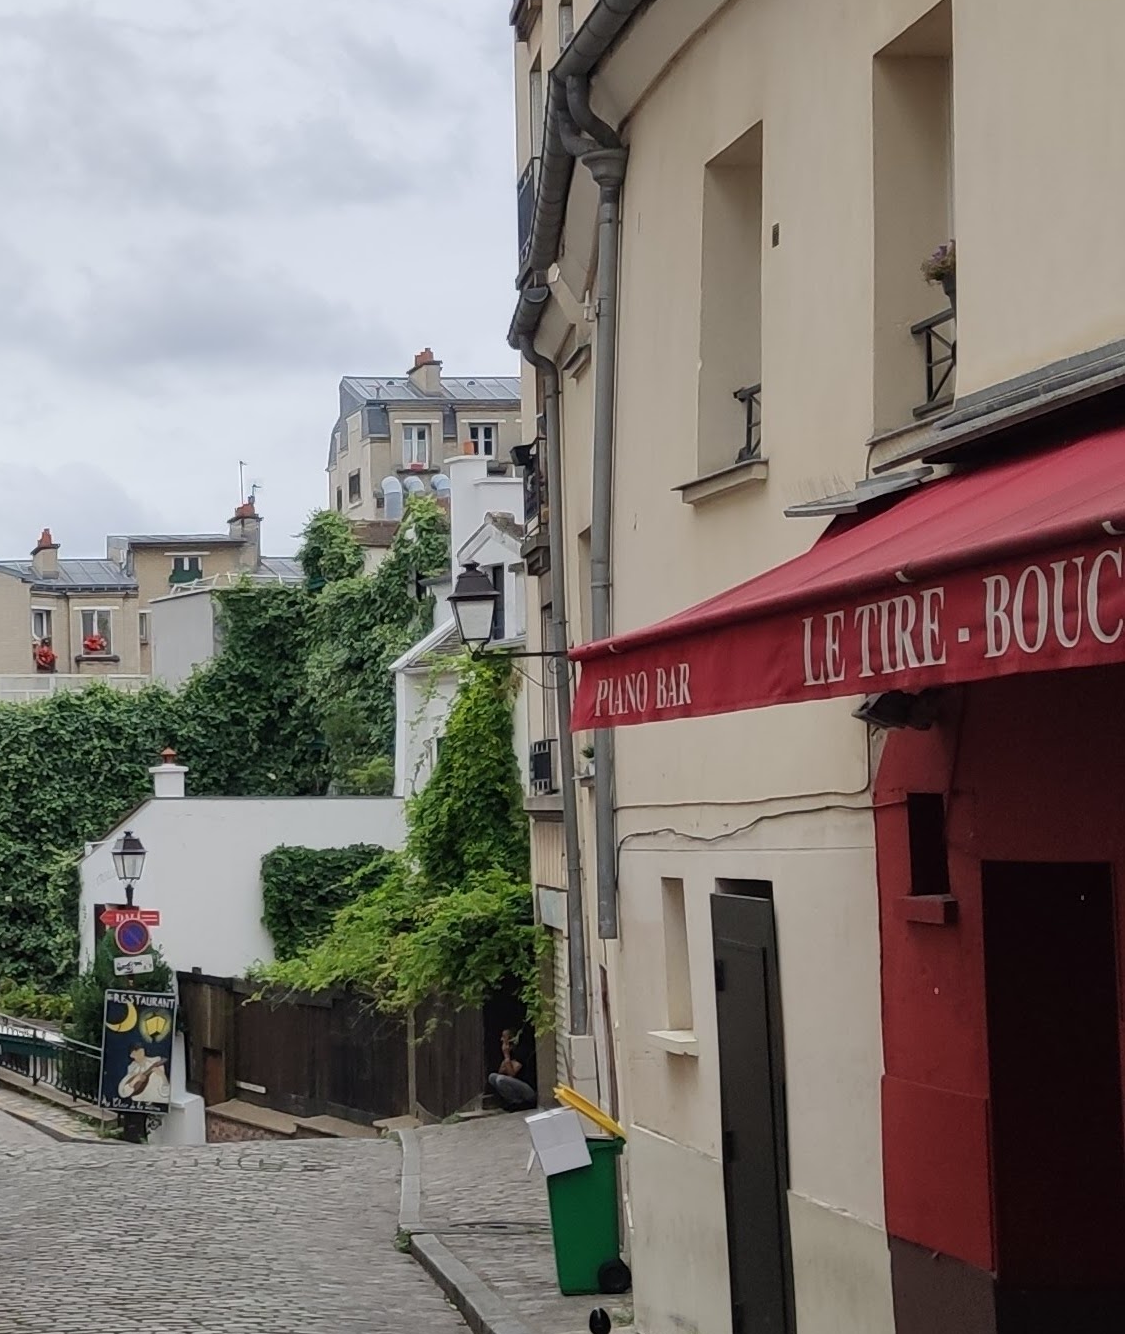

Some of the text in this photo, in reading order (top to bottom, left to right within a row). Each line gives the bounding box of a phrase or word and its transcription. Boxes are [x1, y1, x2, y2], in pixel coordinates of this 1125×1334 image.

[801, 610, 846, 686] LE
[854, 586, 947, 678] TIRE
[594, 663, 692, 717] PIANO BAR
[113, 993, 175, 1009] RESTAURANT
